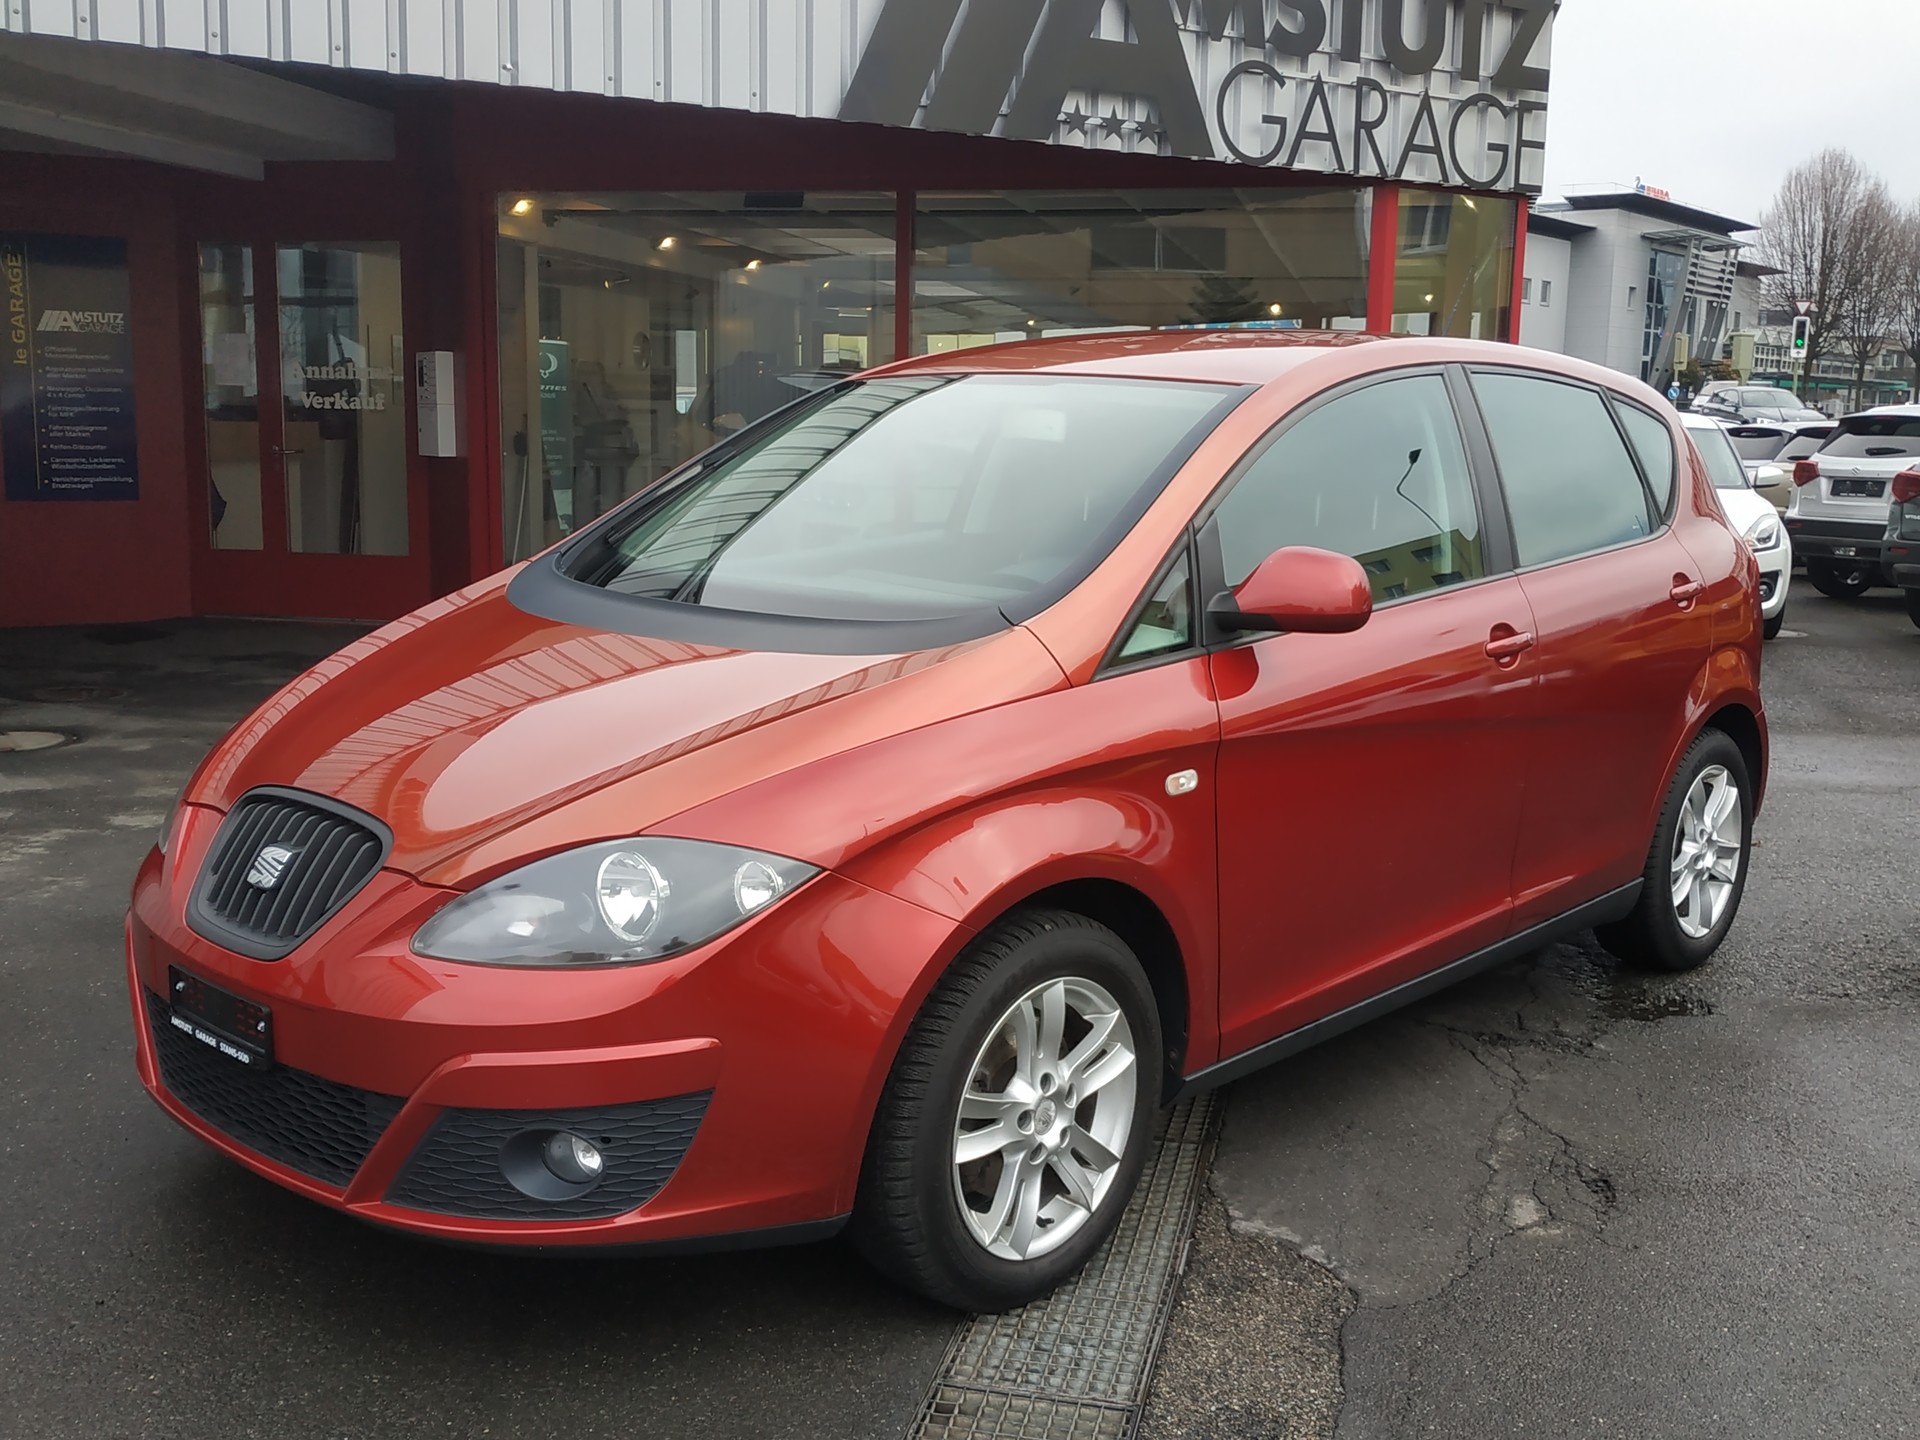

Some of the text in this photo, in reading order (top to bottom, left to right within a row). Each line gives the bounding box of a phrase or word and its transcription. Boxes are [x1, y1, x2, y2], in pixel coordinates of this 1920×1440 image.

[1216, 60, 1548, 193] GARAGE
[7, 253, 28, 365] le GARAGE
[52, 310, 124, 332] AMSTUTZ
[77, 322, 125, 334] GARAGE
[301, 391, 385, 410] Verkauf
[195, 1029, 217, 1048] GARAGE
